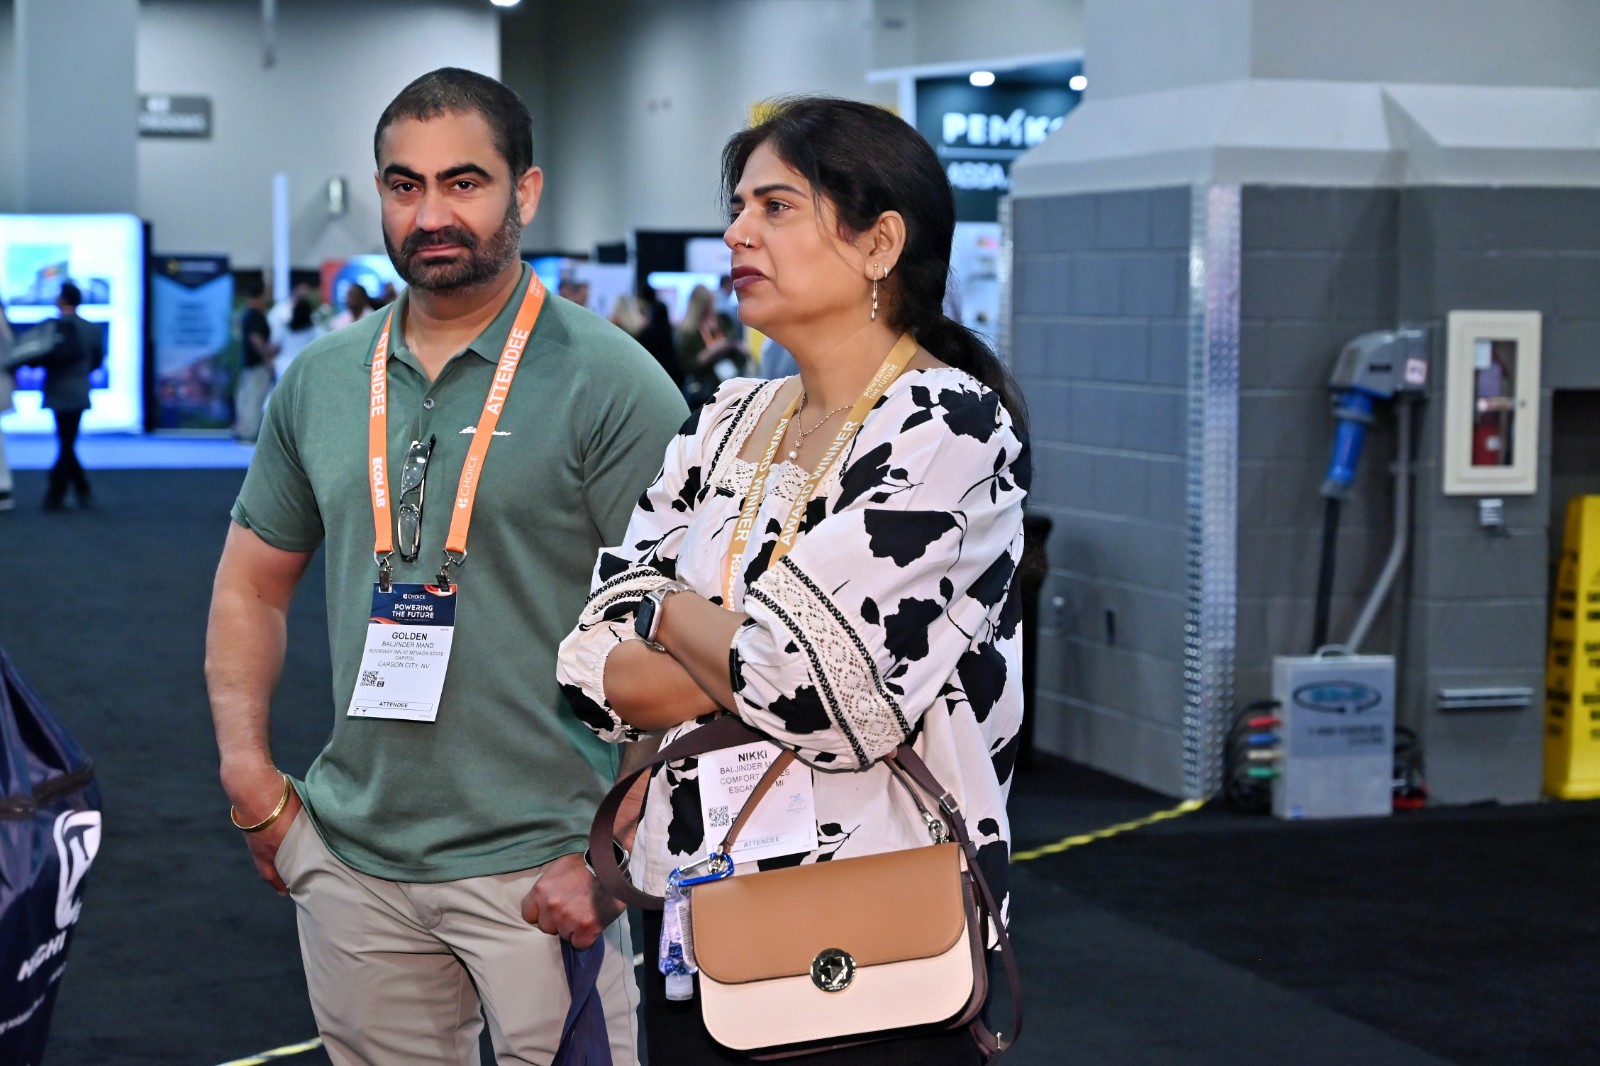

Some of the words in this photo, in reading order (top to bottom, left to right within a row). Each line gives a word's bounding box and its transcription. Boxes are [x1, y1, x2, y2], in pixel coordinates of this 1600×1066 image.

[371, 332, 389, 418] ATTENDEE
[486, 327, 529, 415] ATTENDEE
[864, 362, 890, 397] POWERING
[869, 386, 880, 399] THE
[879, 364, 898, 388] FUTURE
[758, 418, 789, 472] AWARD
[372, 456, 386, 508] ECOLAB
[460, 455, 479, 497] CHOICE
[780, 483, 815, 546] AWARD
[811, 421, 859, 480] WINNER
[734, 474, 766, 542] WINNER
[394, 603, 434, 612] POWERING
[407, 611, 434, 619] FUTURE
[391, 632, 428, 641] GOLDEN
[379, 701, 409, 709] ATTENDEE
[720, 762, 763, 775] BALJINDER
[738, 750, 768, 762] NIKKI
[719, 773, 760, 785] COMFORT
[743, 835, 780, 848] ATTENDEE
